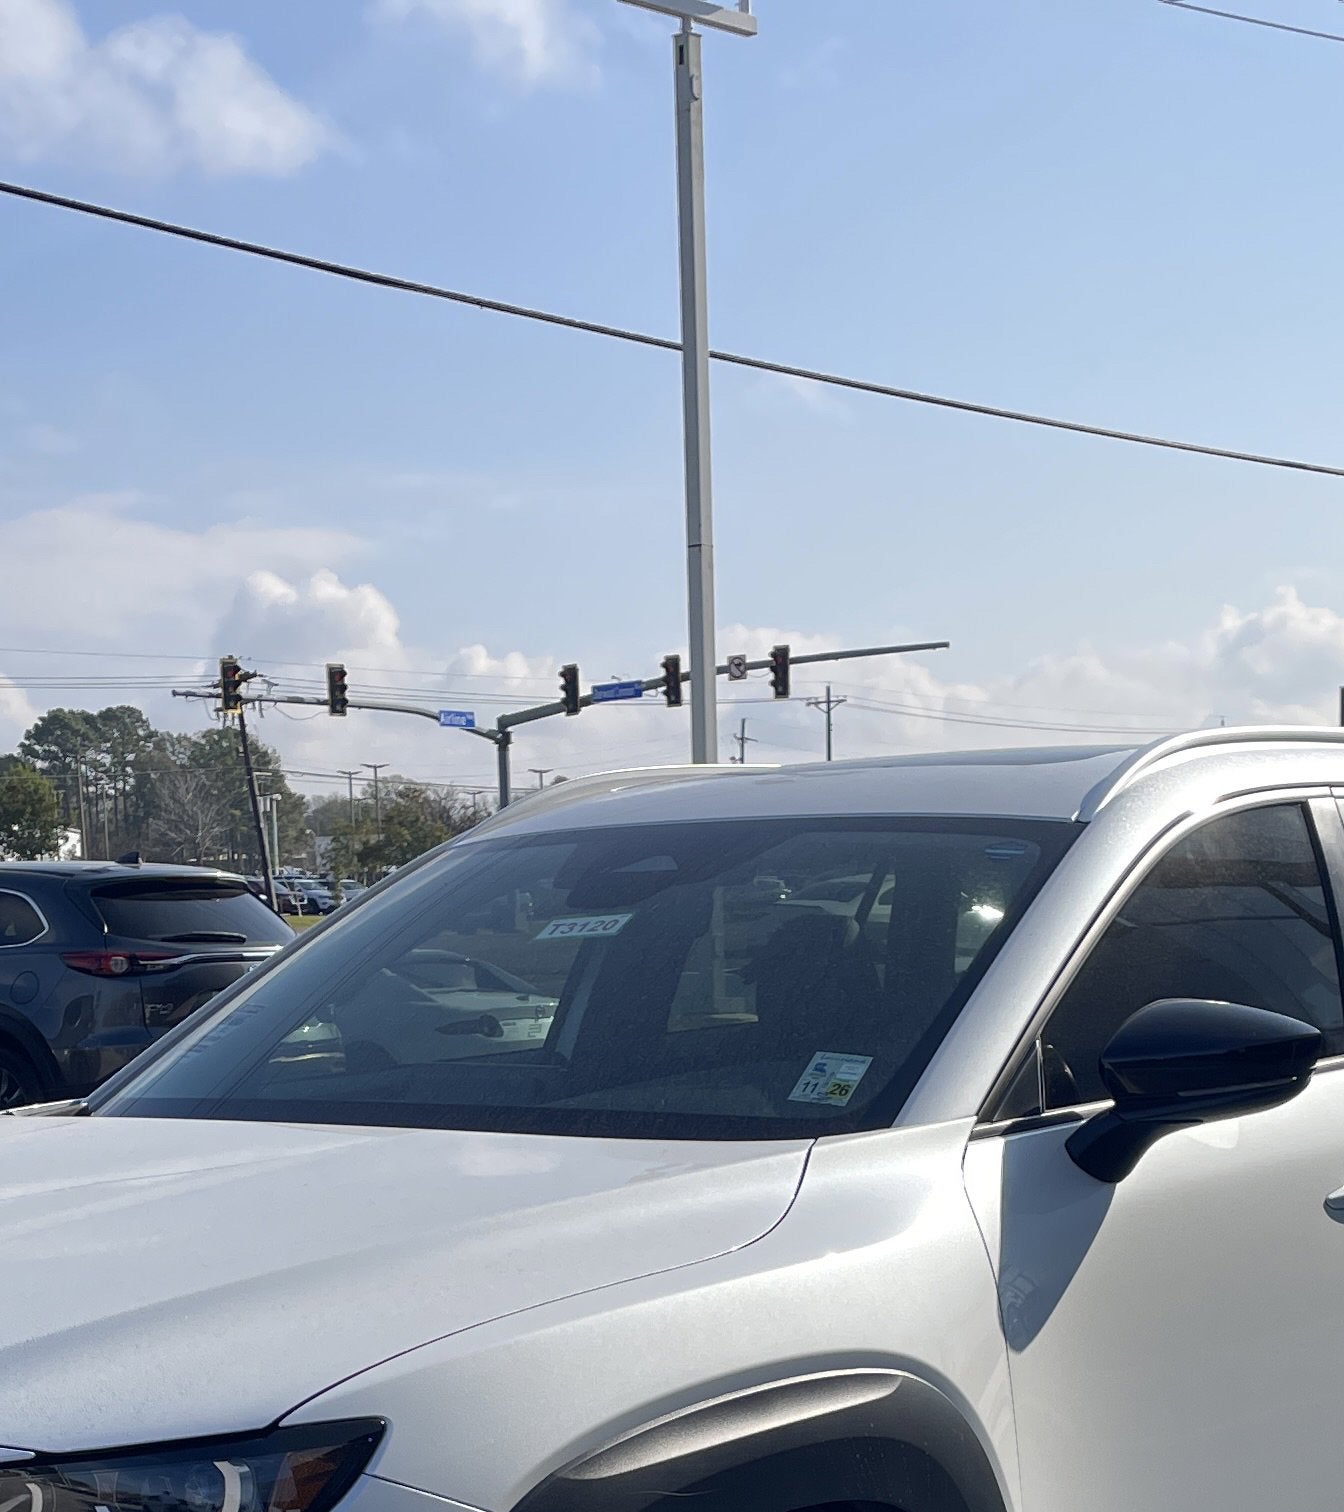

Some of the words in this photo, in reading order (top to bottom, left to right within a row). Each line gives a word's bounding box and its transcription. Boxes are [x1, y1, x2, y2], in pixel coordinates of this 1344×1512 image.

[548, 919, 621, 936] T3120
[801, 1080, 819, 1093] 11
[829, 1083, 852, 1096] 26
